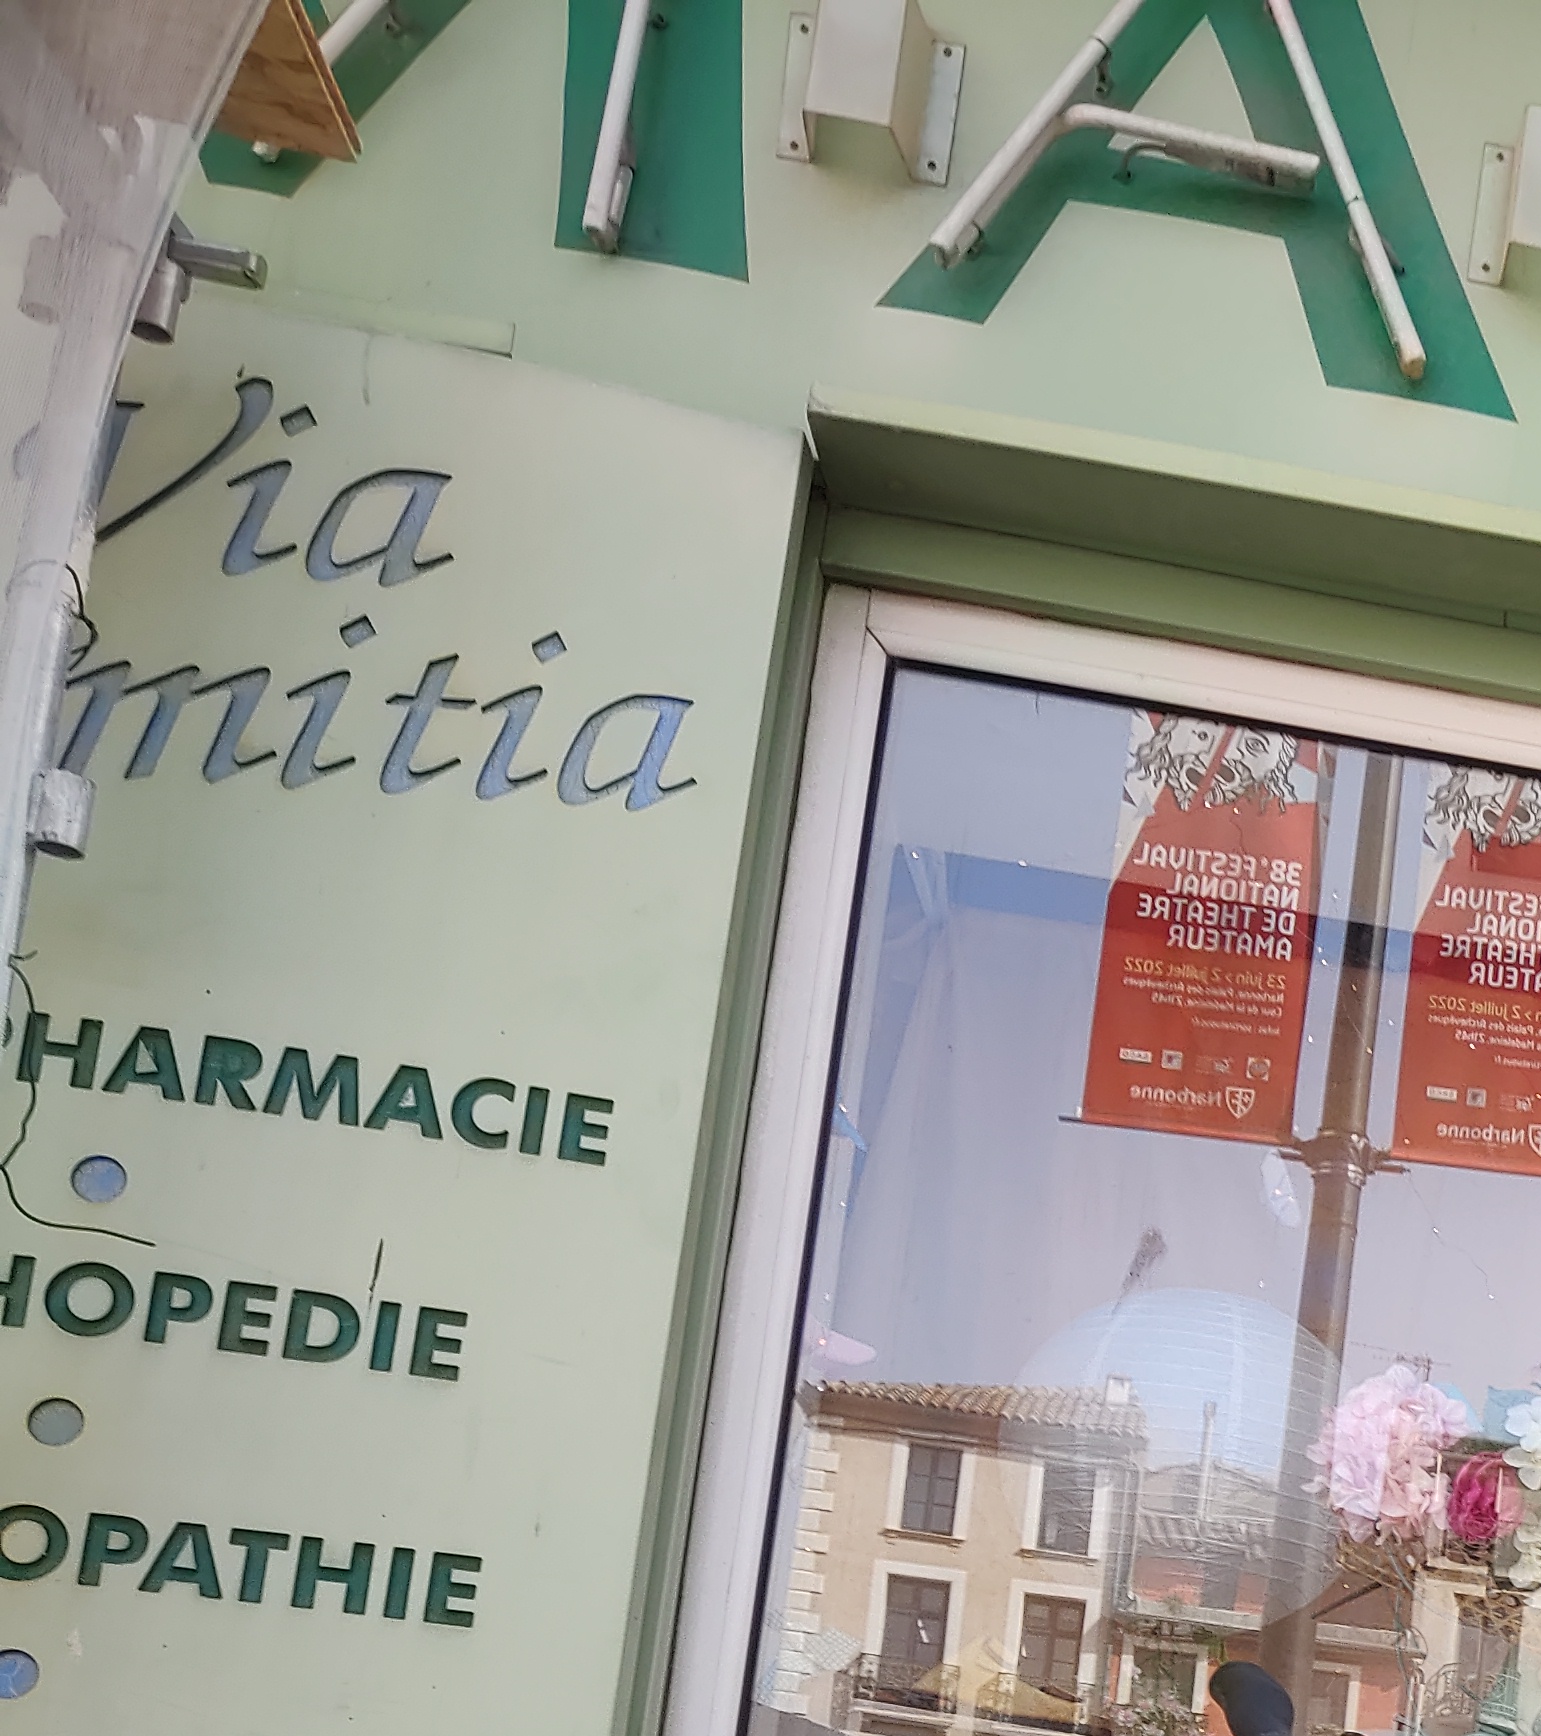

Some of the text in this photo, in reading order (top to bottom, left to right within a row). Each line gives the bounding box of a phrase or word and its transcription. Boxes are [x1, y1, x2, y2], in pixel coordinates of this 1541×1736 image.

[96, 376, 454, 588] Via
[3, 1012, 615, 1166] HARMACIE
[0, 1504, 484, 1628] OPATHIE
